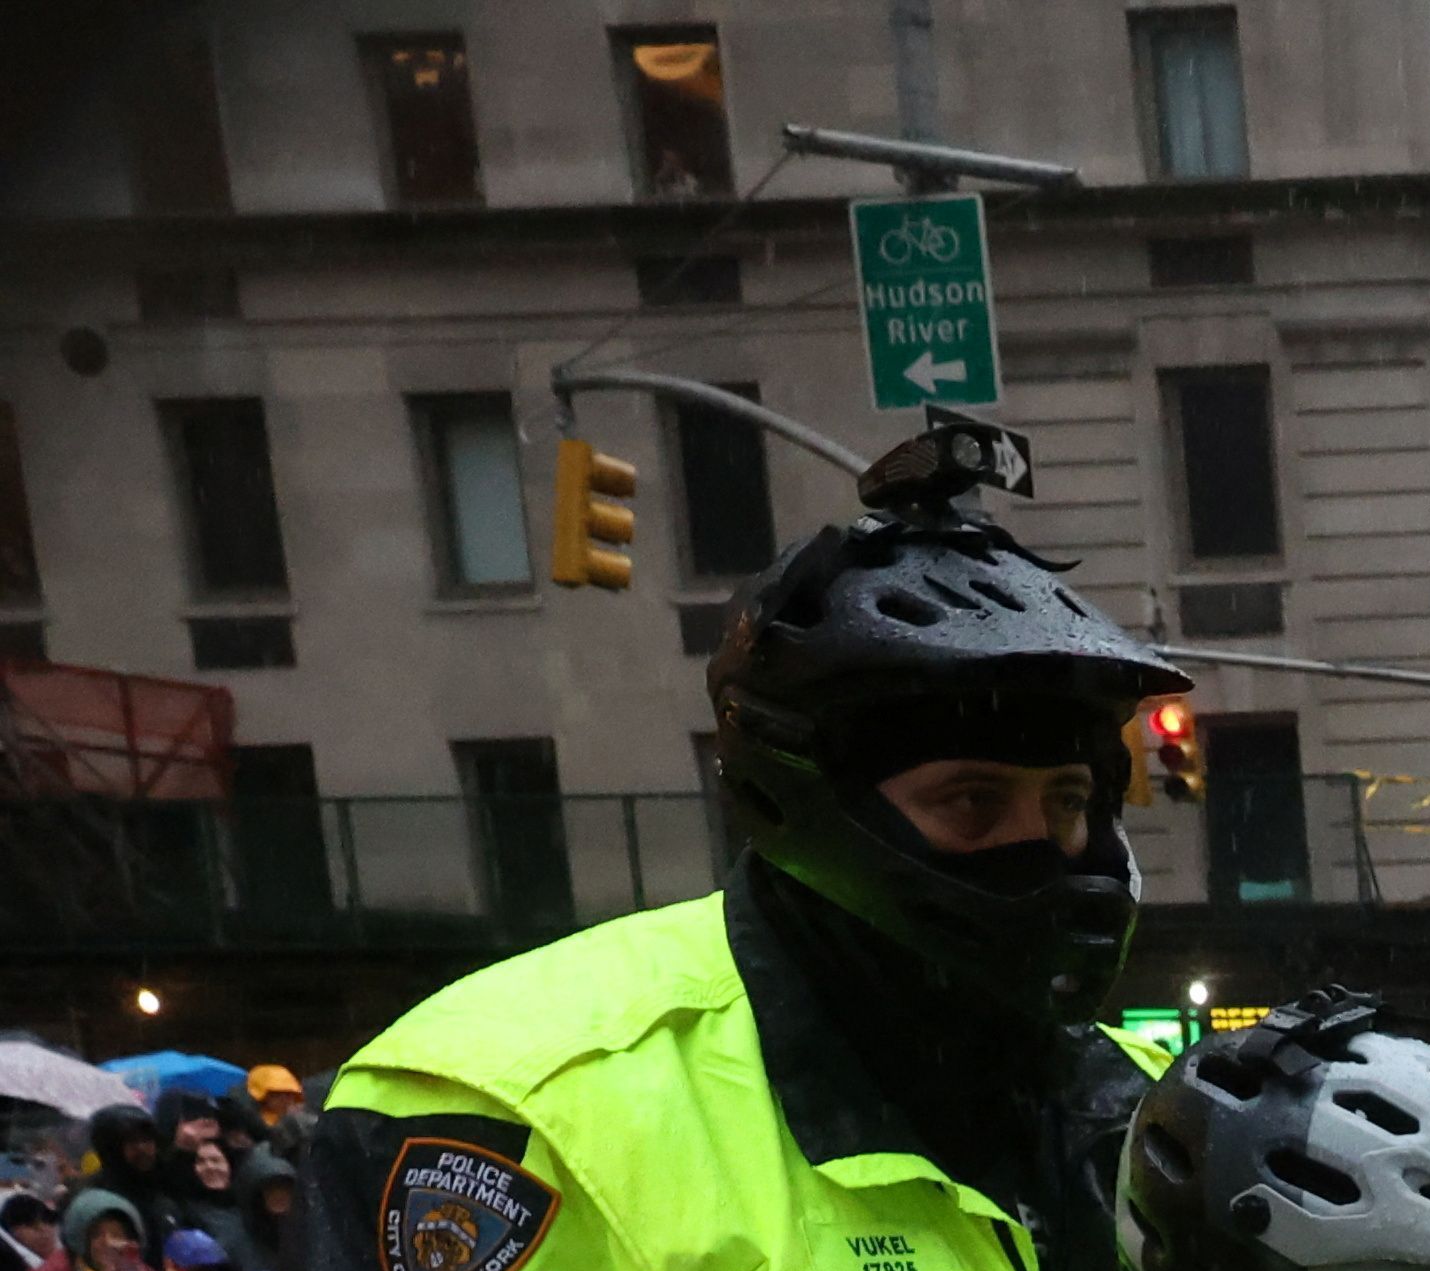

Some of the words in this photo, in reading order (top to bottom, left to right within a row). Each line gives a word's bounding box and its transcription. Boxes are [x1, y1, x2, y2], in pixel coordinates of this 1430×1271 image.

[864, 278, 985, 309] Hudson
[887, 315, 969, 345] River
[437, 1152, 513, 1193] POLICE
[404, 1168, 532, 1228] DEPARTMENT
[387, 1209, 402, 1259] CITY
[845, 1234, 916, 1257] VUKEL
